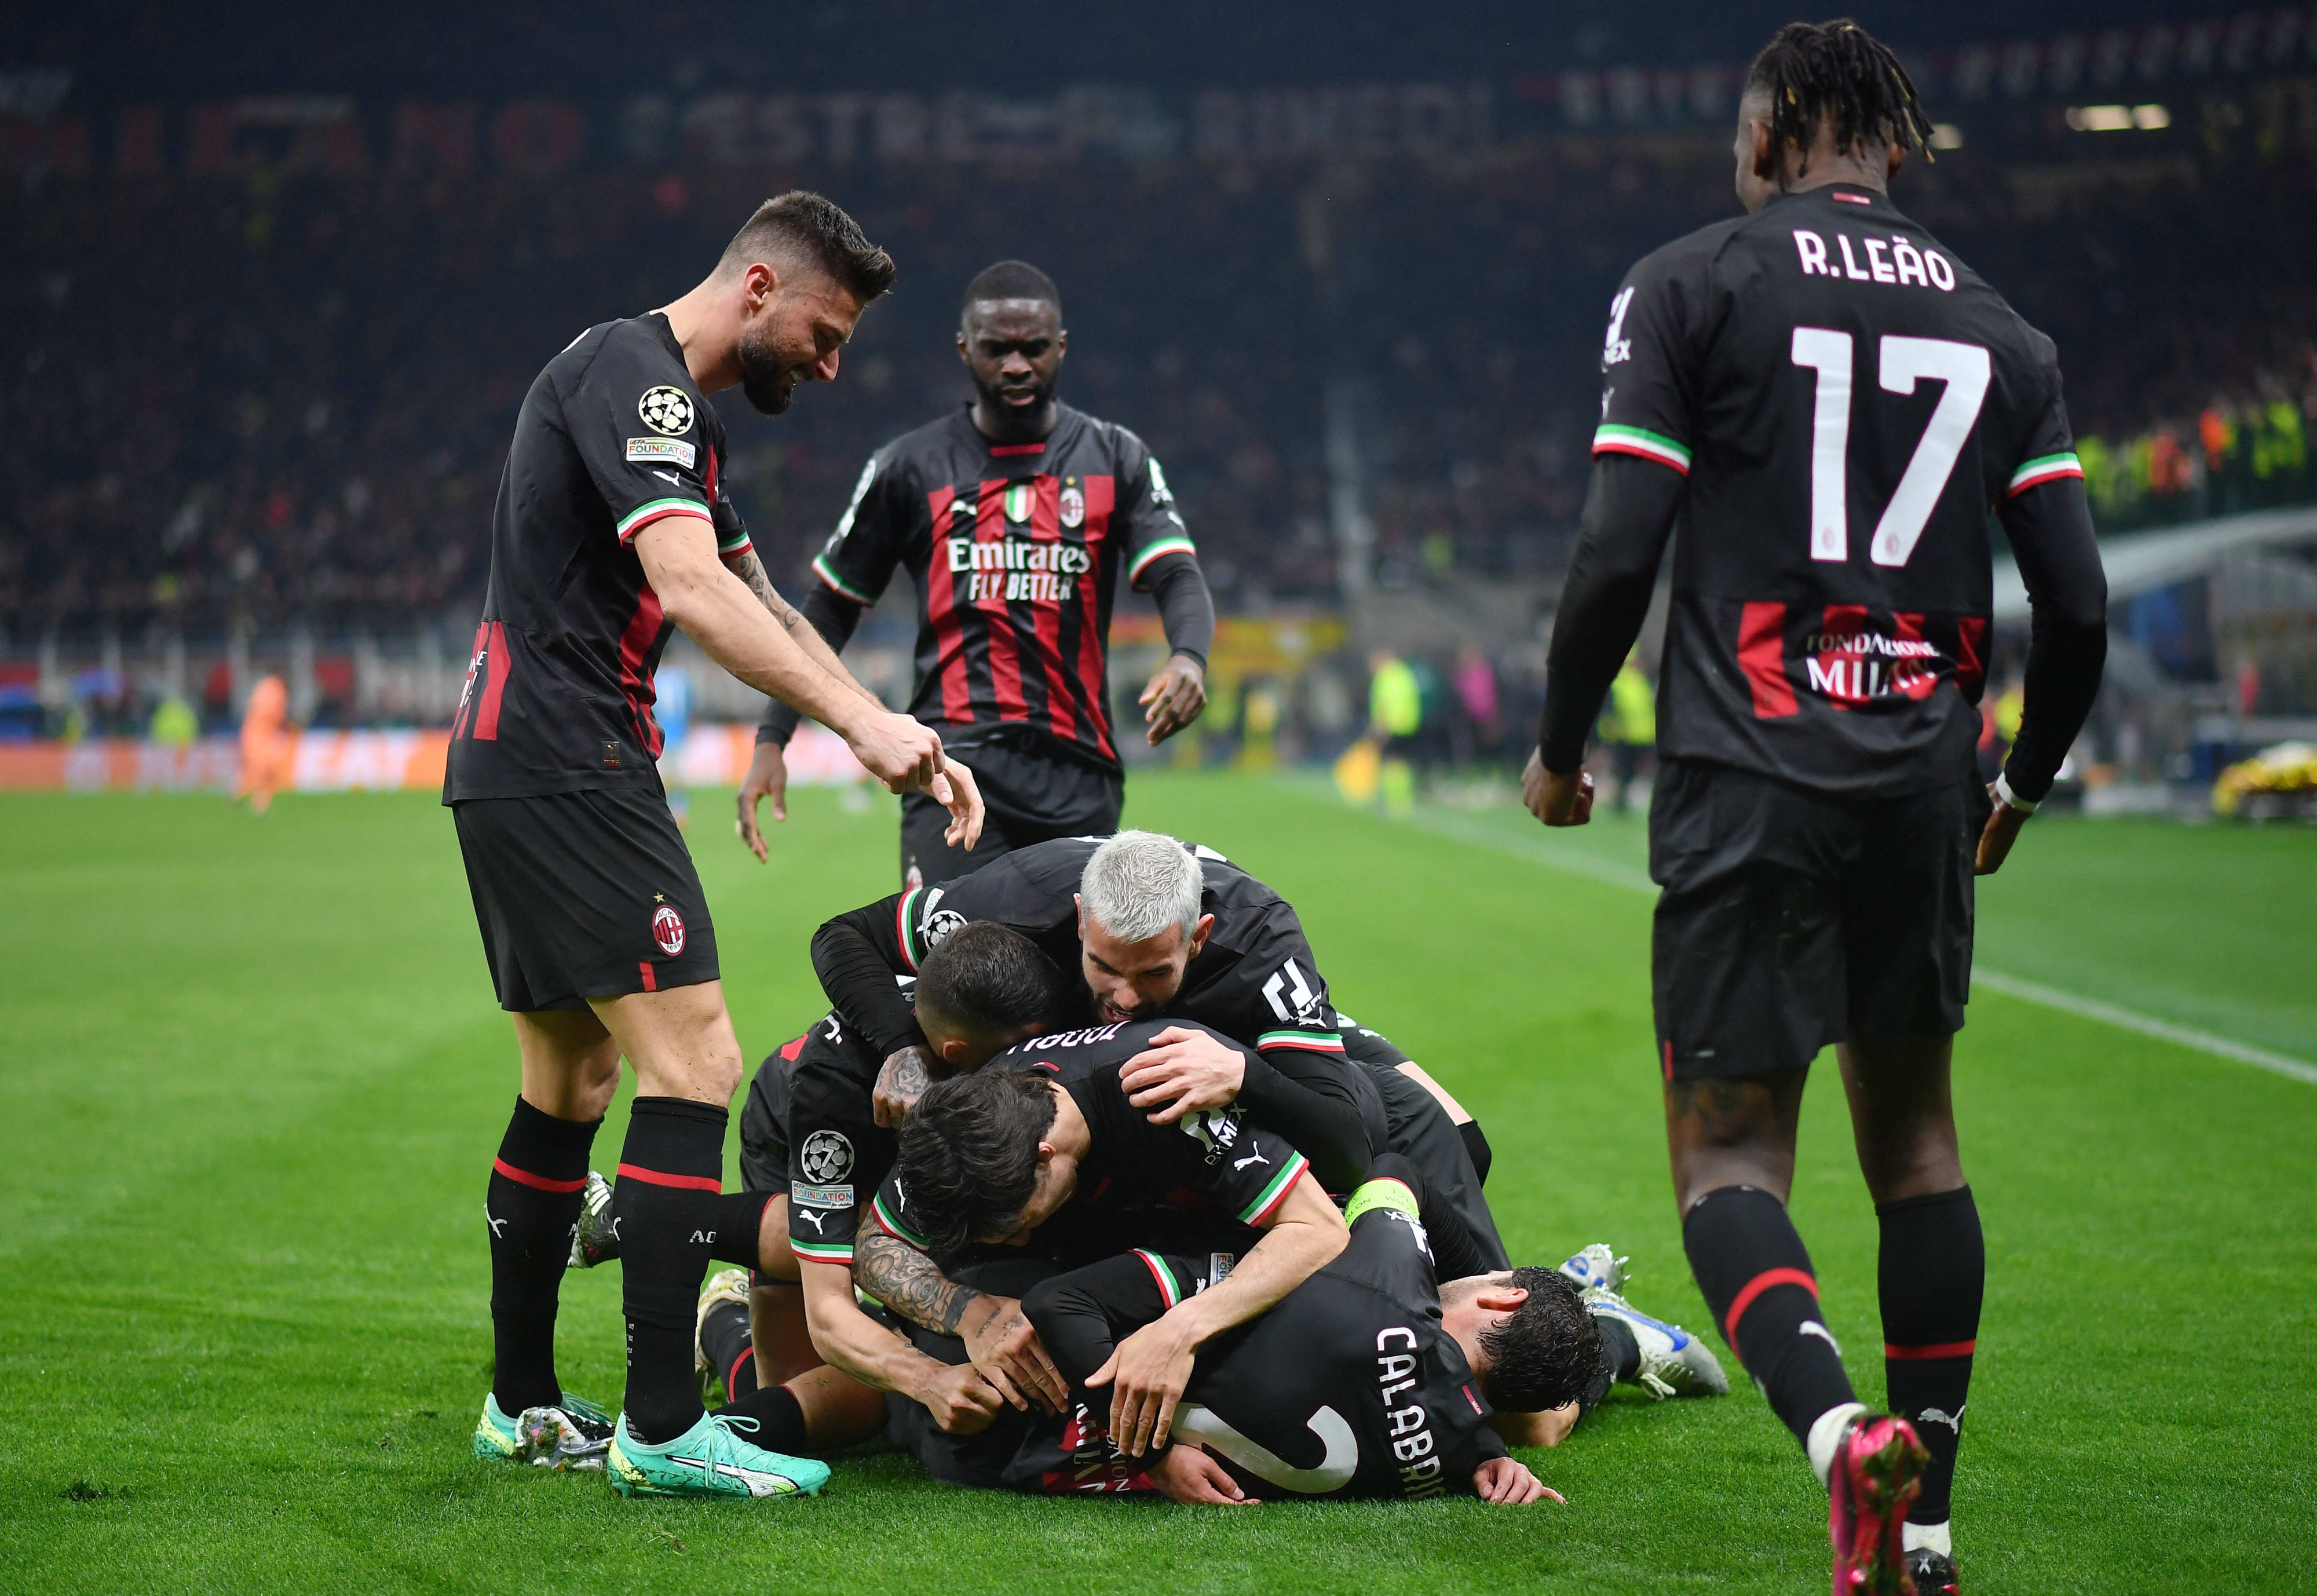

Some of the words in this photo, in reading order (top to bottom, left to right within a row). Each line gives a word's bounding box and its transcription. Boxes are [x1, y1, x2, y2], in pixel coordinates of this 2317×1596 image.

[1793, 229, 1956, 291] R.LEÃO
[629, 444, 693, 461] FOUNDATION
[1791, 326, 1991, 567] 17
[946, 536, 1091, 574] Emirates
[969, 572, 1003, 601] FLY
[1006, 572, 1073, 601] BETTER
[657, 909, 674, 920] ACM
[821, 1147, 835, 1168] 7
[794, 1188, 853, 1201] FOUNDATION
[1170, 1402, 1358, 1494] 2
